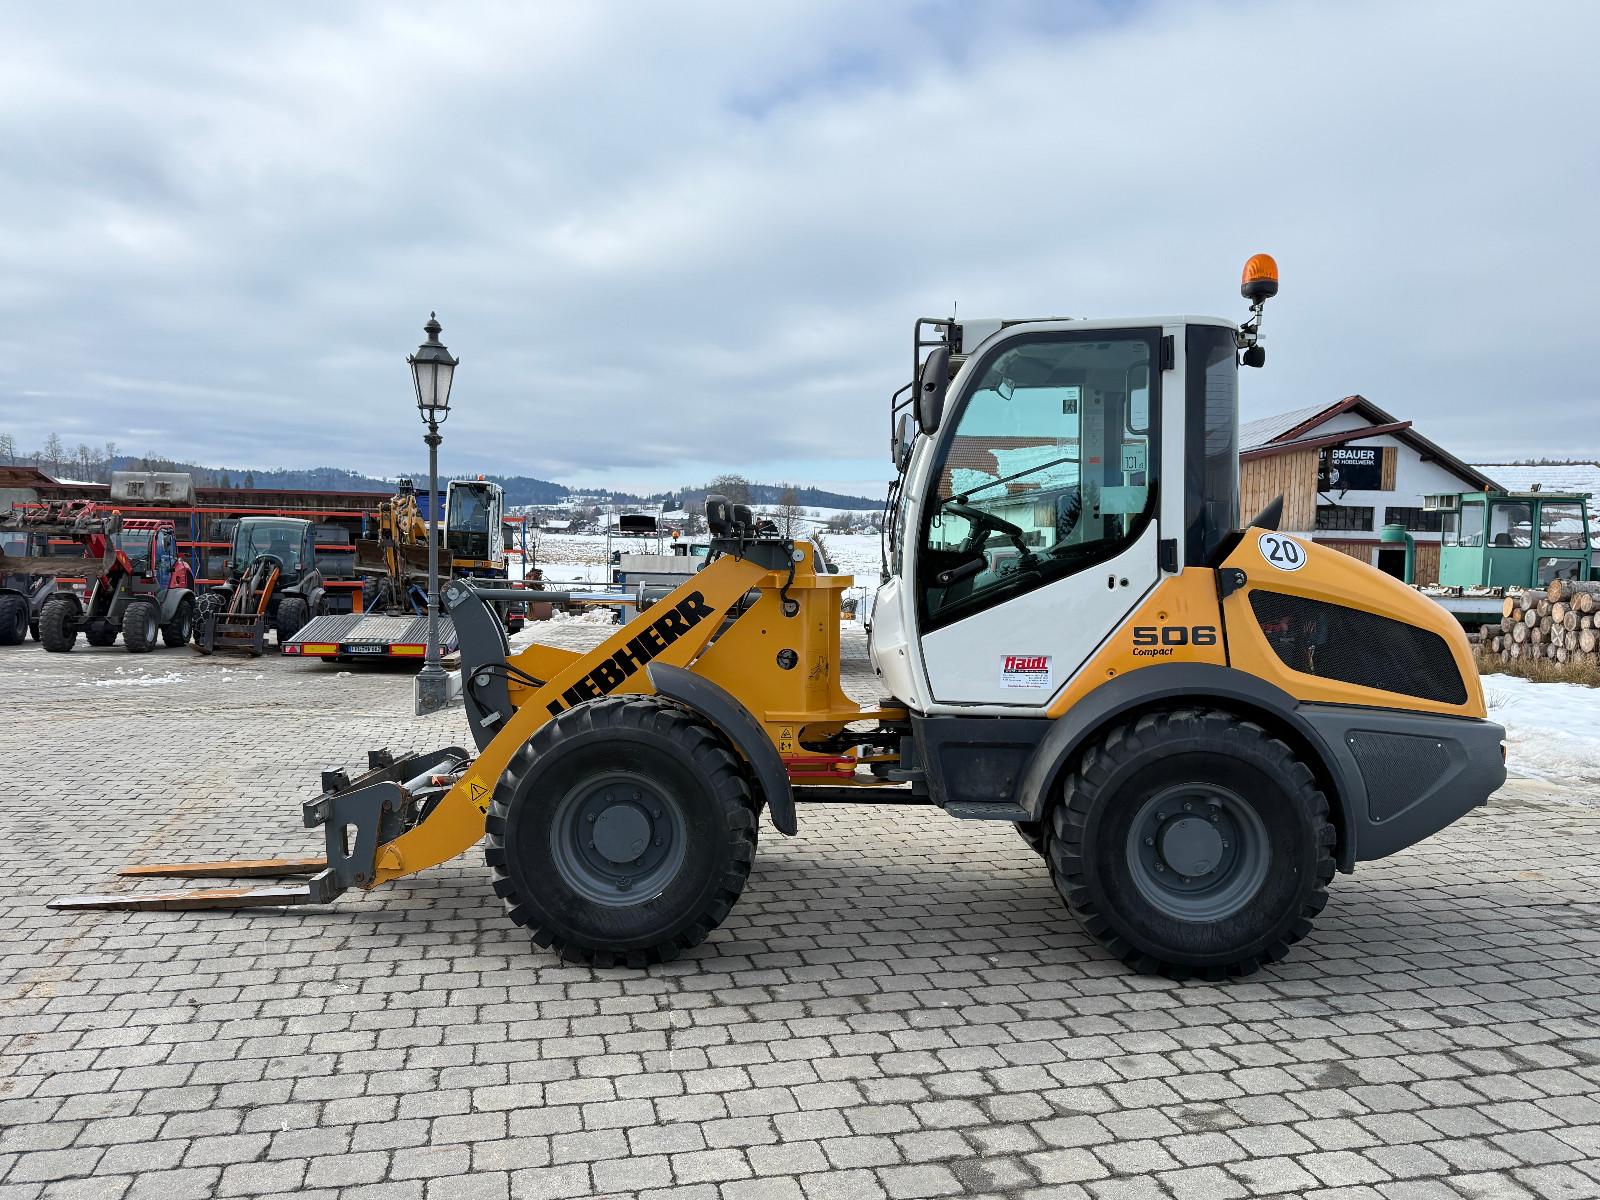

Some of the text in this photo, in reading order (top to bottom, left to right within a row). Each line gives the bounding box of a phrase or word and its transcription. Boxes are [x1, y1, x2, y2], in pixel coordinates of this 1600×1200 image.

[1331, 449, 1375, 460] GBAUER
[1266, 537, 1299, 564] 20
[1132, 626, 1217, 646] 506
[1132, 647, 1174, 658] Compact
